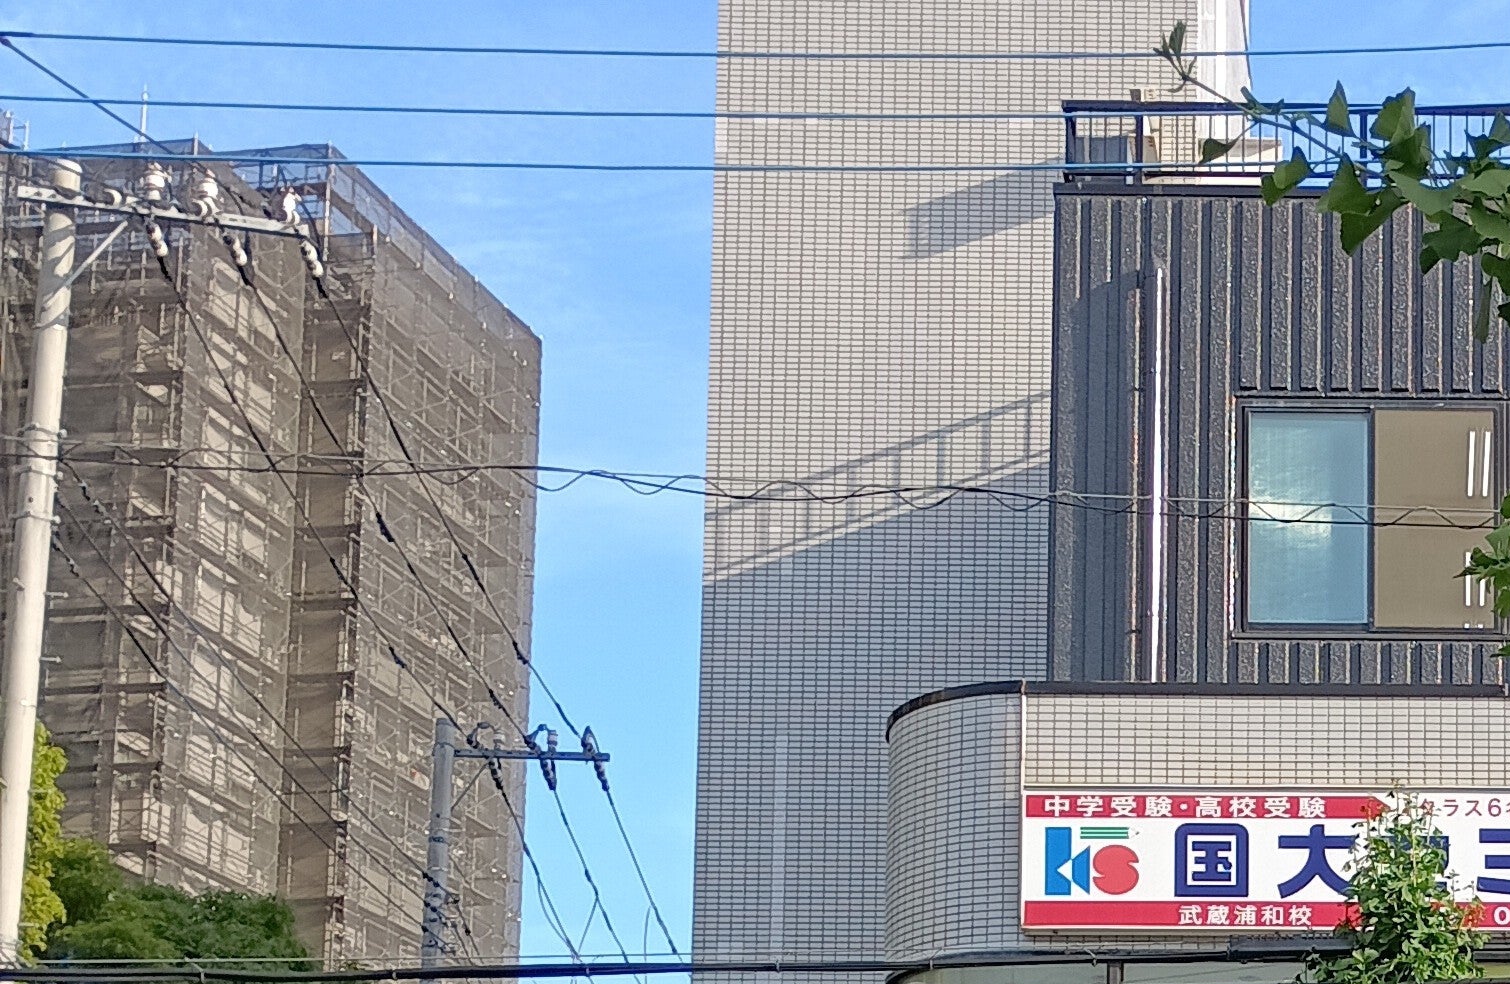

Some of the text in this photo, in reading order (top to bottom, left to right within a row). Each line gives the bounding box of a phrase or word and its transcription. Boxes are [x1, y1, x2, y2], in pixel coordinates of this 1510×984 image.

[1044, 795, 1327, 819] 中学受験・高校受験
[1178, 904, 1313, 926] 武蔵浦和校
